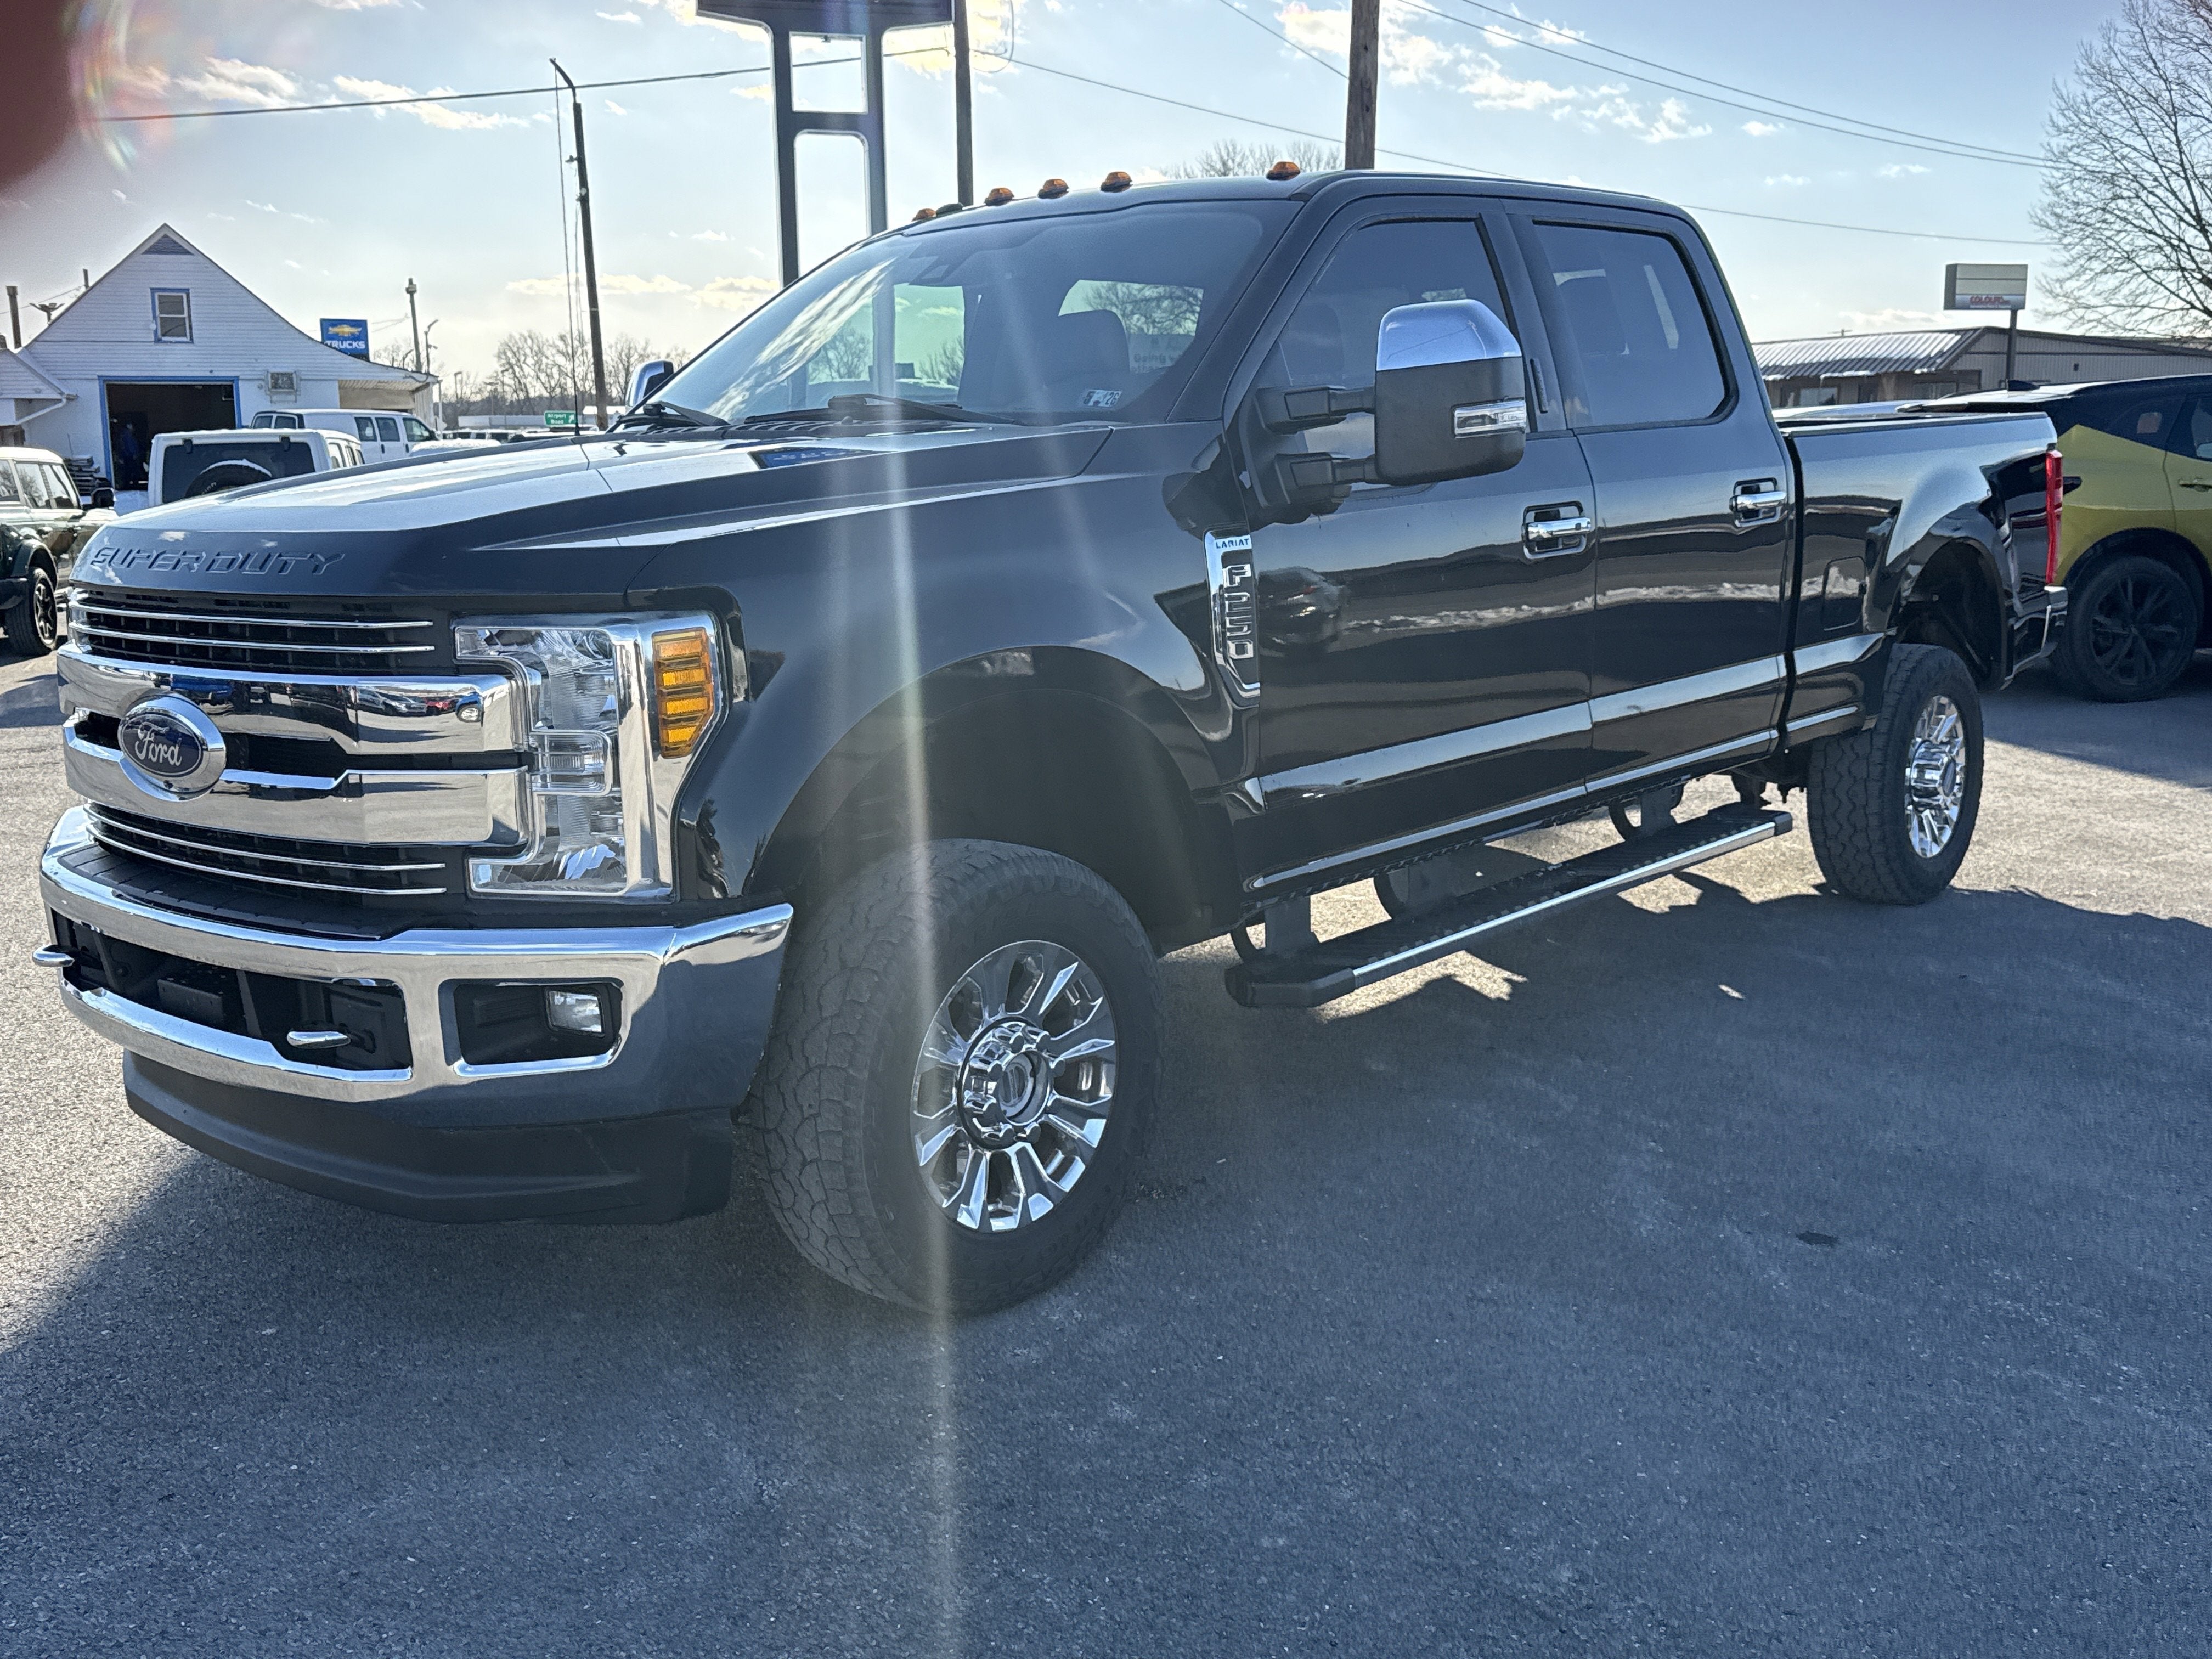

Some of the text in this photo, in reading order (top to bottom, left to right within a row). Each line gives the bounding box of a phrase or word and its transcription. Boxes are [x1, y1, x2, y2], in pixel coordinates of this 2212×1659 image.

[324, 341, 365, 349] TRUCKS
[1105, 392, 1119, 405] 26
[1215, 538, 1249, 549] LARIAT
[90, 546, 346, 575] SUPER DUTY
[1222, 563, 1254, 659] F250
[135, 721, 182, 766] Ford
